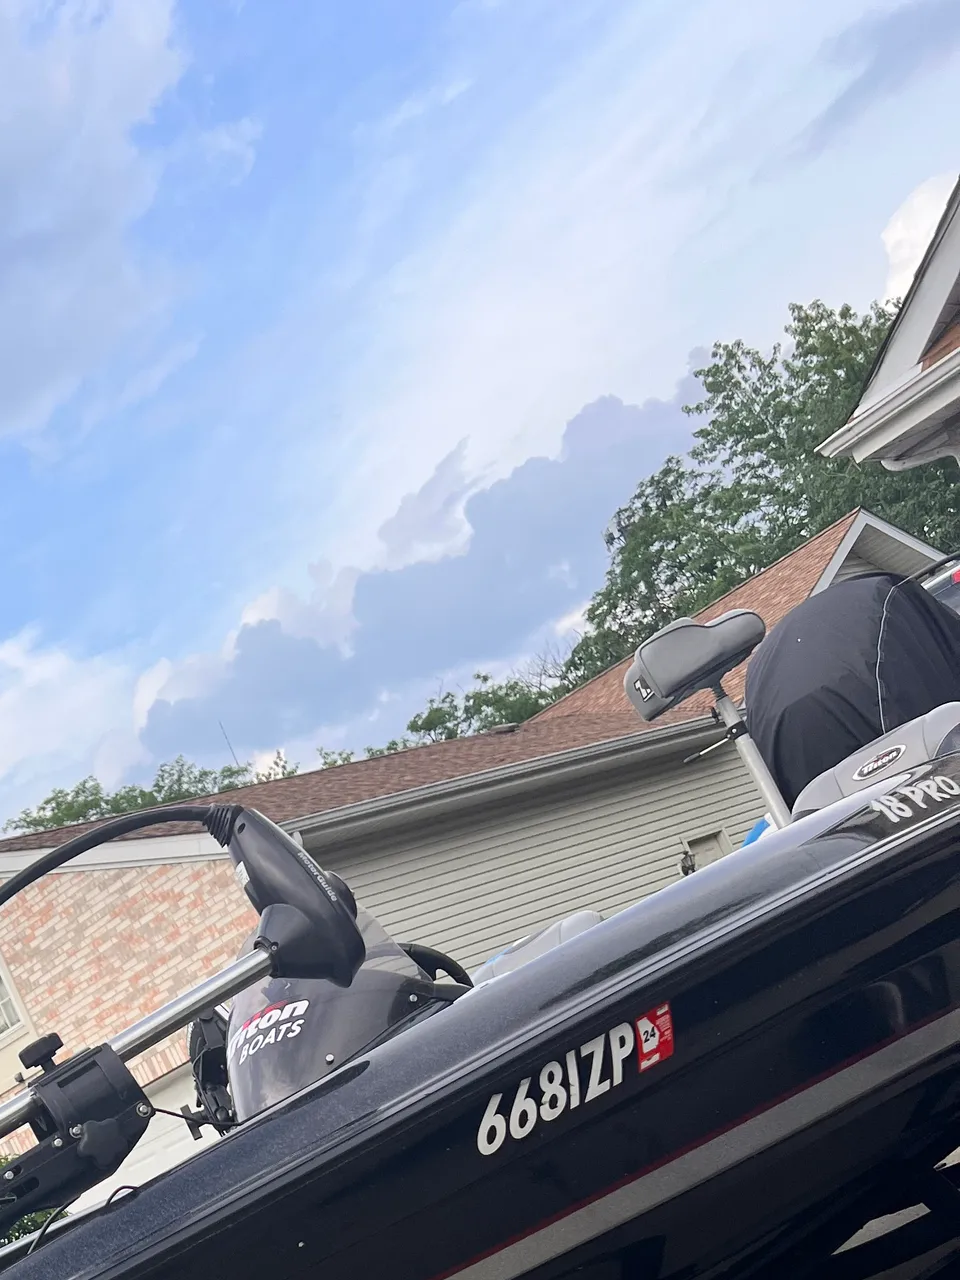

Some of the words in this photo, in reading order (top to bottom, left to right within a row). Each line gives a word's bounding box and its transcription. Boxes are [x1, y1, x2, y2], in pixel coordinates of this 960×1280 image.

[861, 750, 898, 775] Triton
[871, 795, 914, 823] 18
[897, 775, 960, 809] PRO
[297, 851, 338, 902] MotorGuide
[239, 1019, 305, 1066] BOATS
[643, 1026, 656, 1044] 24
